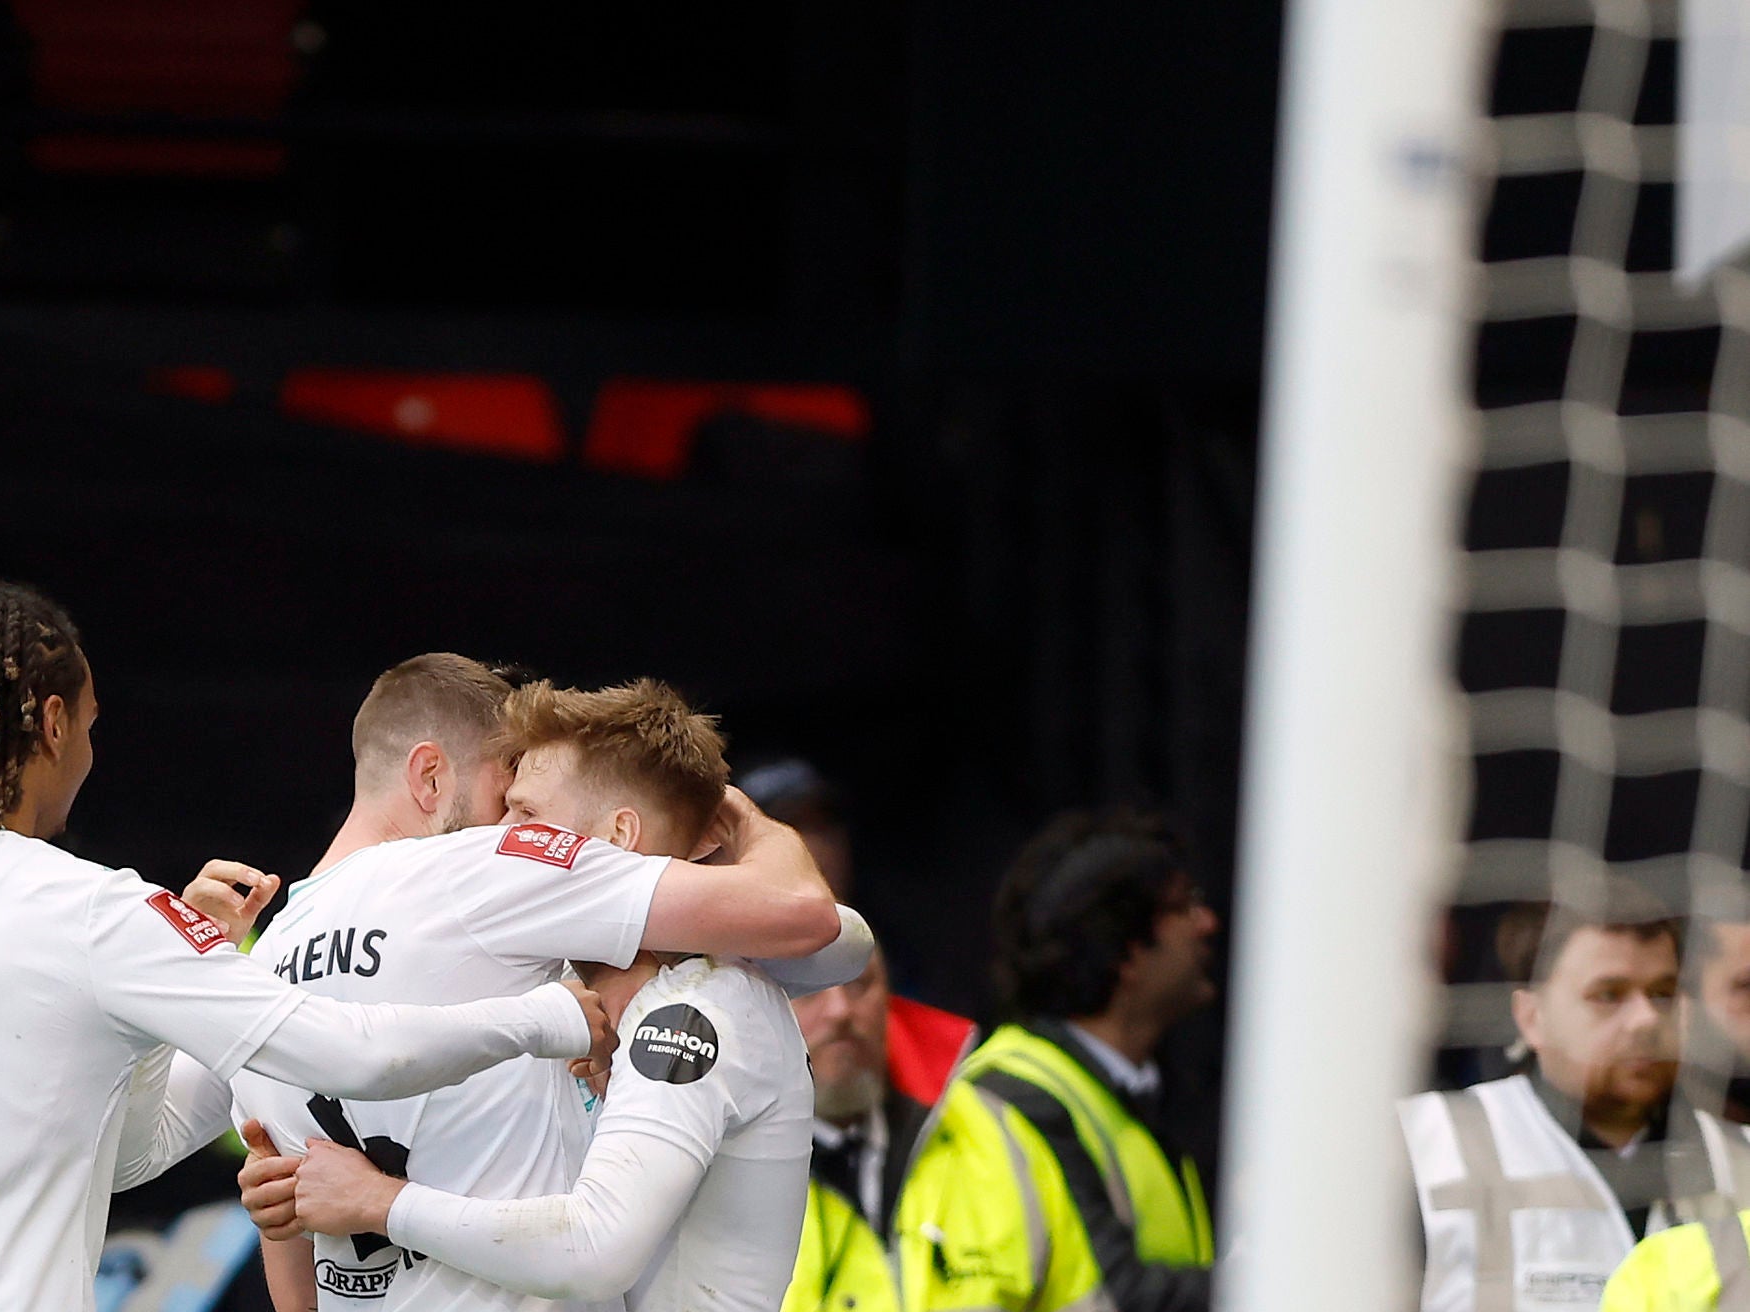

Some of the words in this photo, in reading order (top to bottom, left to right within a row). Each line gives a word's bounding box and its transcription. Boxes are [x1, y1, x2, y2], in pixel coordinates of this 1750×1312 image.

[274, 927, 387, 984] HENS
[647, 1044, 682, 1057] FREIGHT
[682, 1051, 696, 1063] UK
